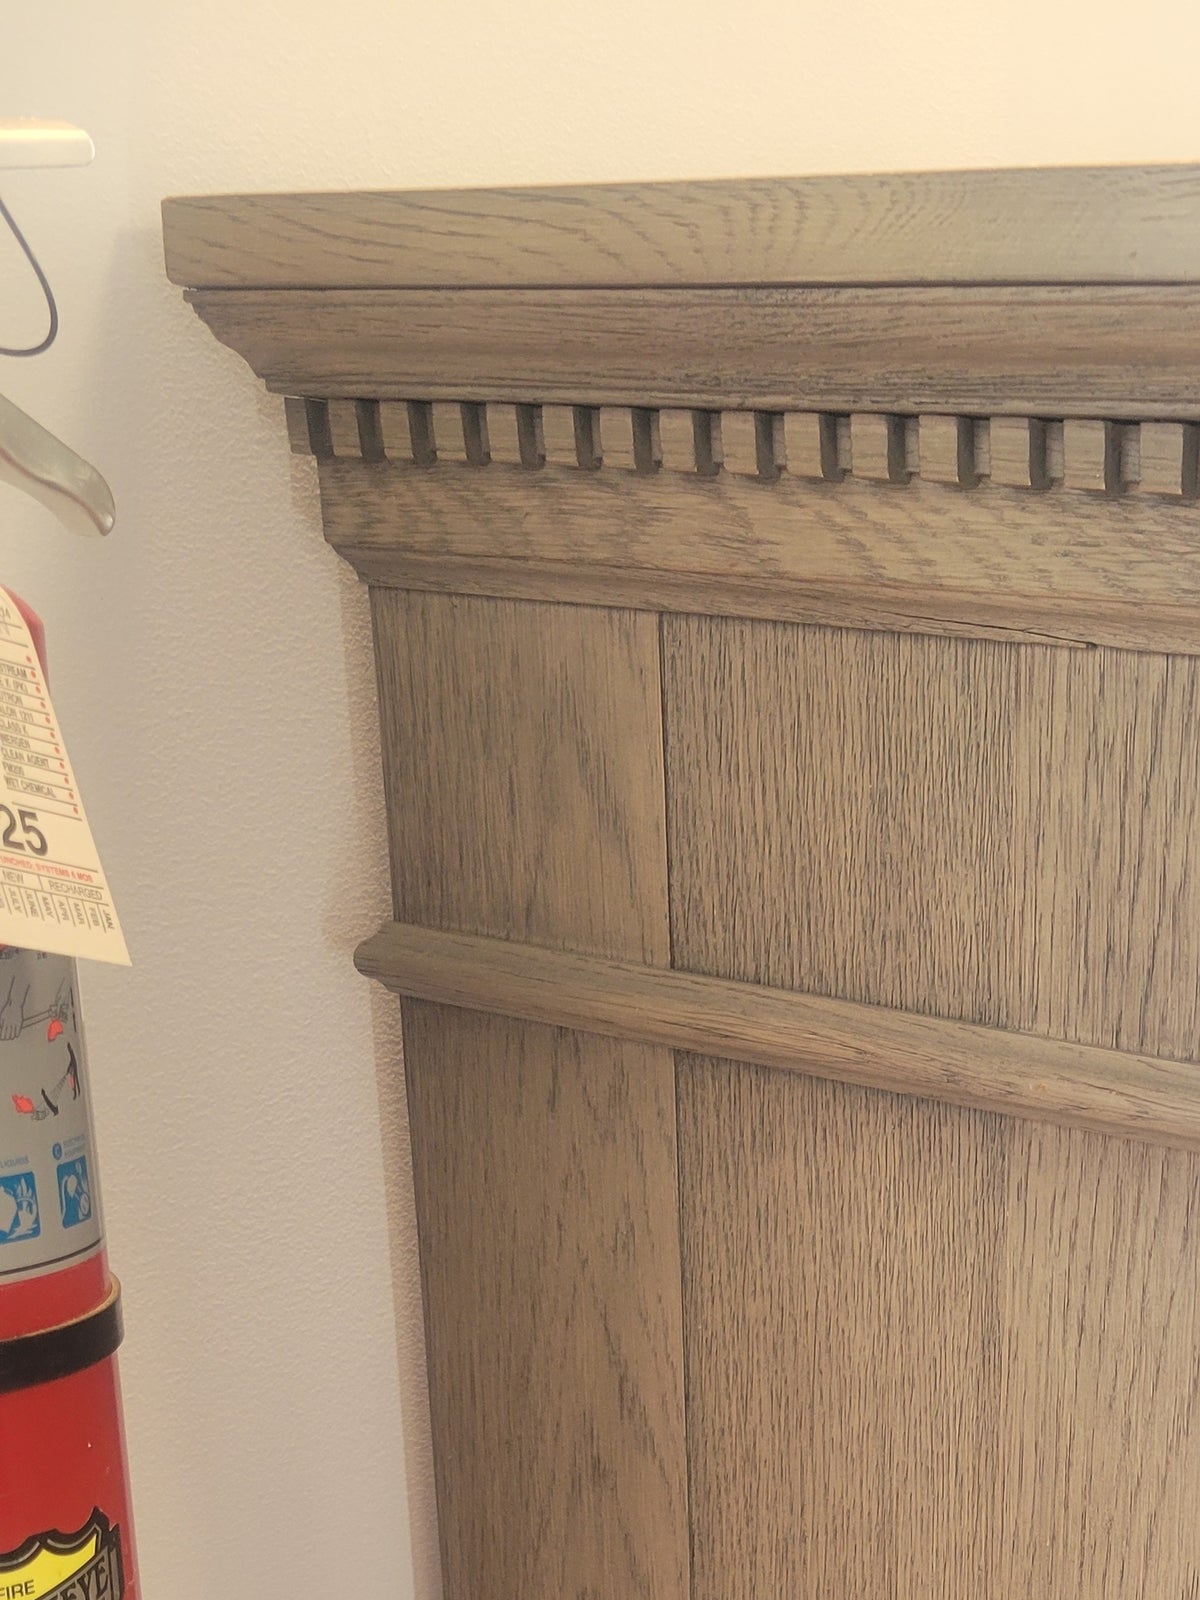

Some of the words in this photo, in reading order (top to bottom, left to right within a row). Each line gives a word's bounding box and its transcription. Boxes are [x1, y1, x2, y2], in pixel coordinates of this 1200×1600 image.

[0, 804, 48, 857] 25
[3, 870, 24, 884] NEW
[48, 880, 103, 901] RECHARGED
[25, 891, 39, 918] JUNE
[41, 896, 55, 919] MAY
[58, 899, 70, 921] APR
[73, 902, 85, 925] MAR
[103, 909, 115, 930] JAN
